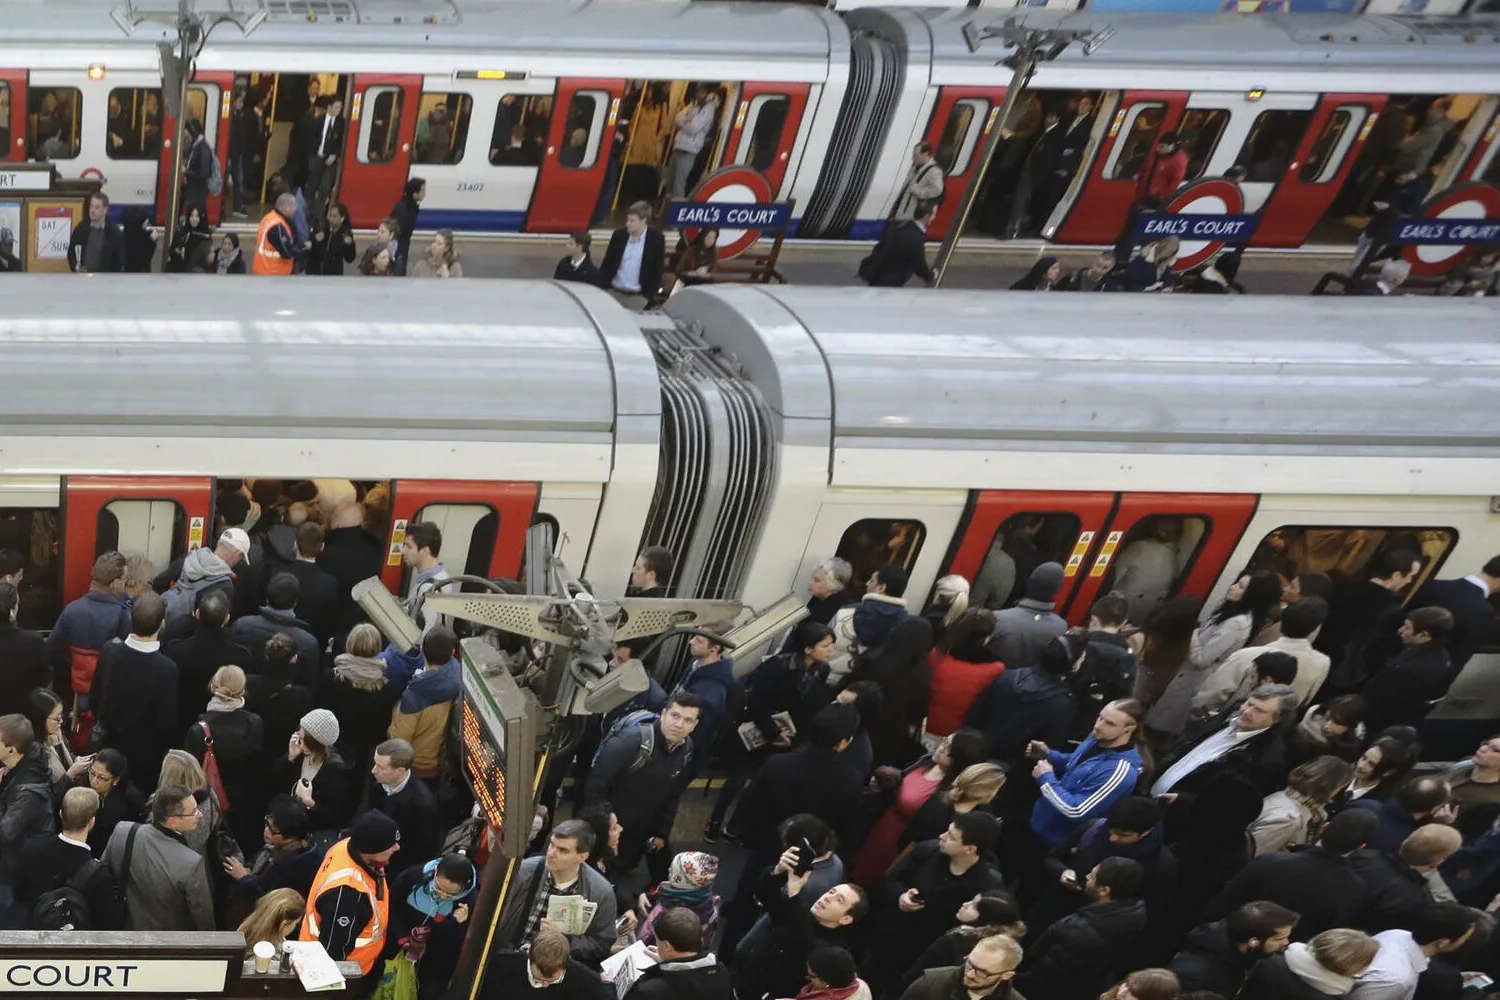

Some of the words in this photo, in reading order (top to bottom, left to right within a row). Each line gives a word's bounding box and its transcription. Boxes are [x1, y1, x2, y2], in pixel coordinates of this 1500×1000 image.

[677, 206, 721, 222] EARL'S
[726, 209, 778, 224] COURT
[41, 220, 56, 230] SAT
[1143, 218, 1189, 234] EARL'S
[1193, 220, 1245, 235] COURT
[6, 965, 138, 987] COURT
